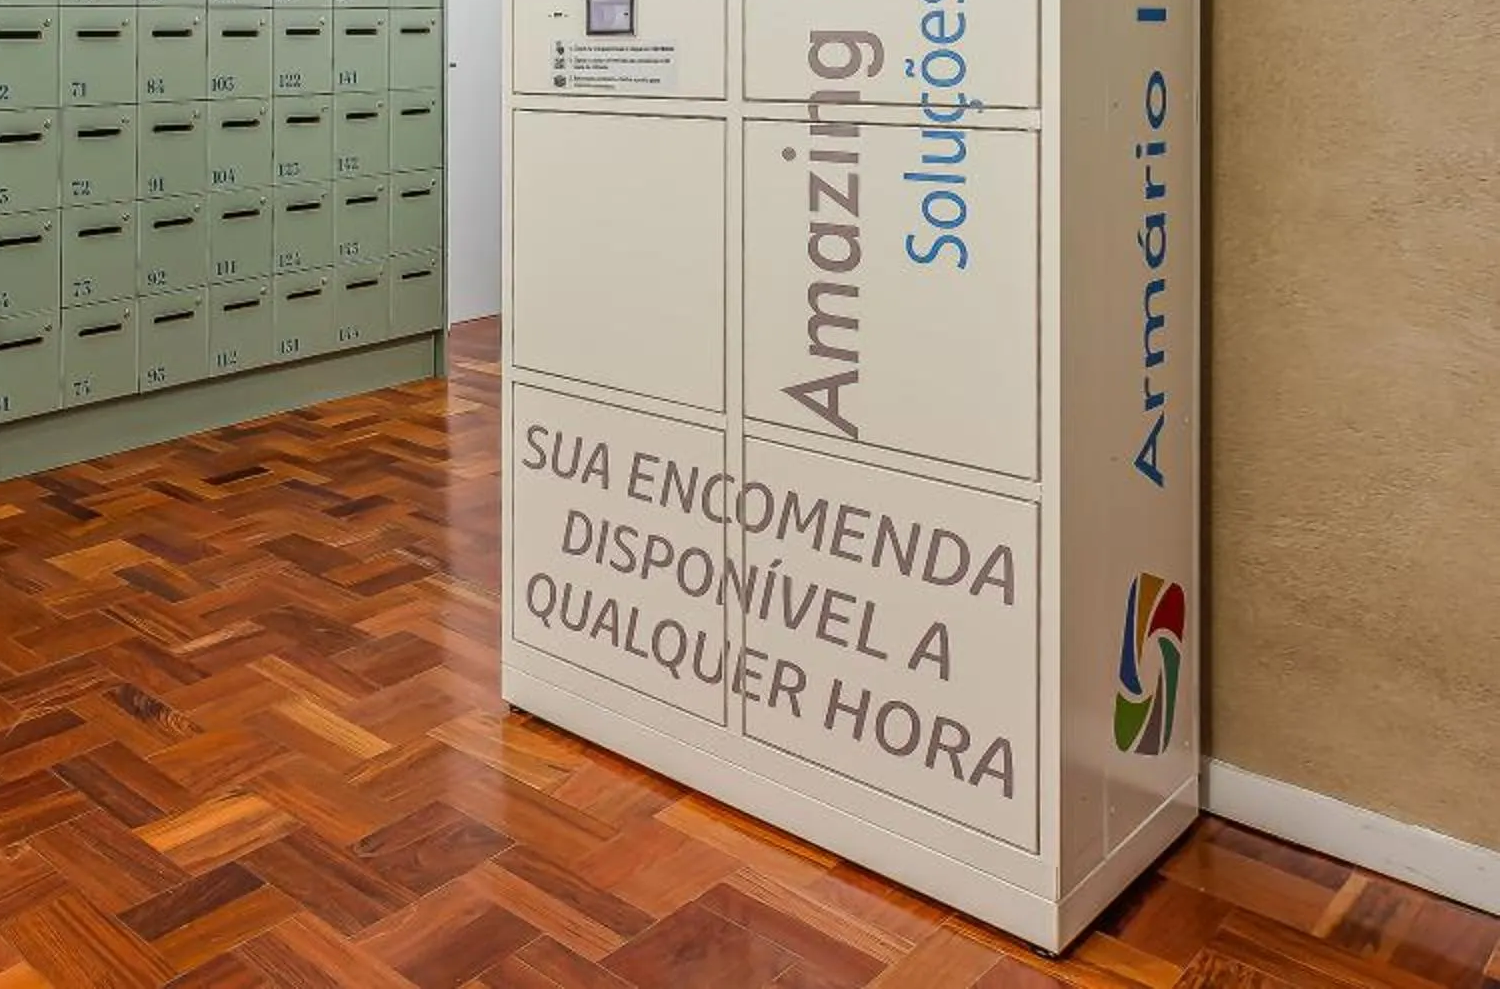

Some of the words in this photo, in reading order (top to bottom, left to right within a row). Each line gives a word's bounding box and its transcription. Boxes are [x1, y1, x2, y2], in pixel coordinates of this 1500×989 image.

[212, 168, 236, 184] 104
[780, 29, 884, 440] Amazing
[147, 269, 166, 286] 92
[1133, 70, 1167, 488] Armário
[521, 424, 610, 490] SUA
[627, 452, 1015, 606] ENCOMENDA
[561, 509, 888, 660] DISPONÍVEL
[908, 621, 950, 681] A
[526, 572, 806, 718] QUALQUER
[824, 678, 1014, 799] HORA
